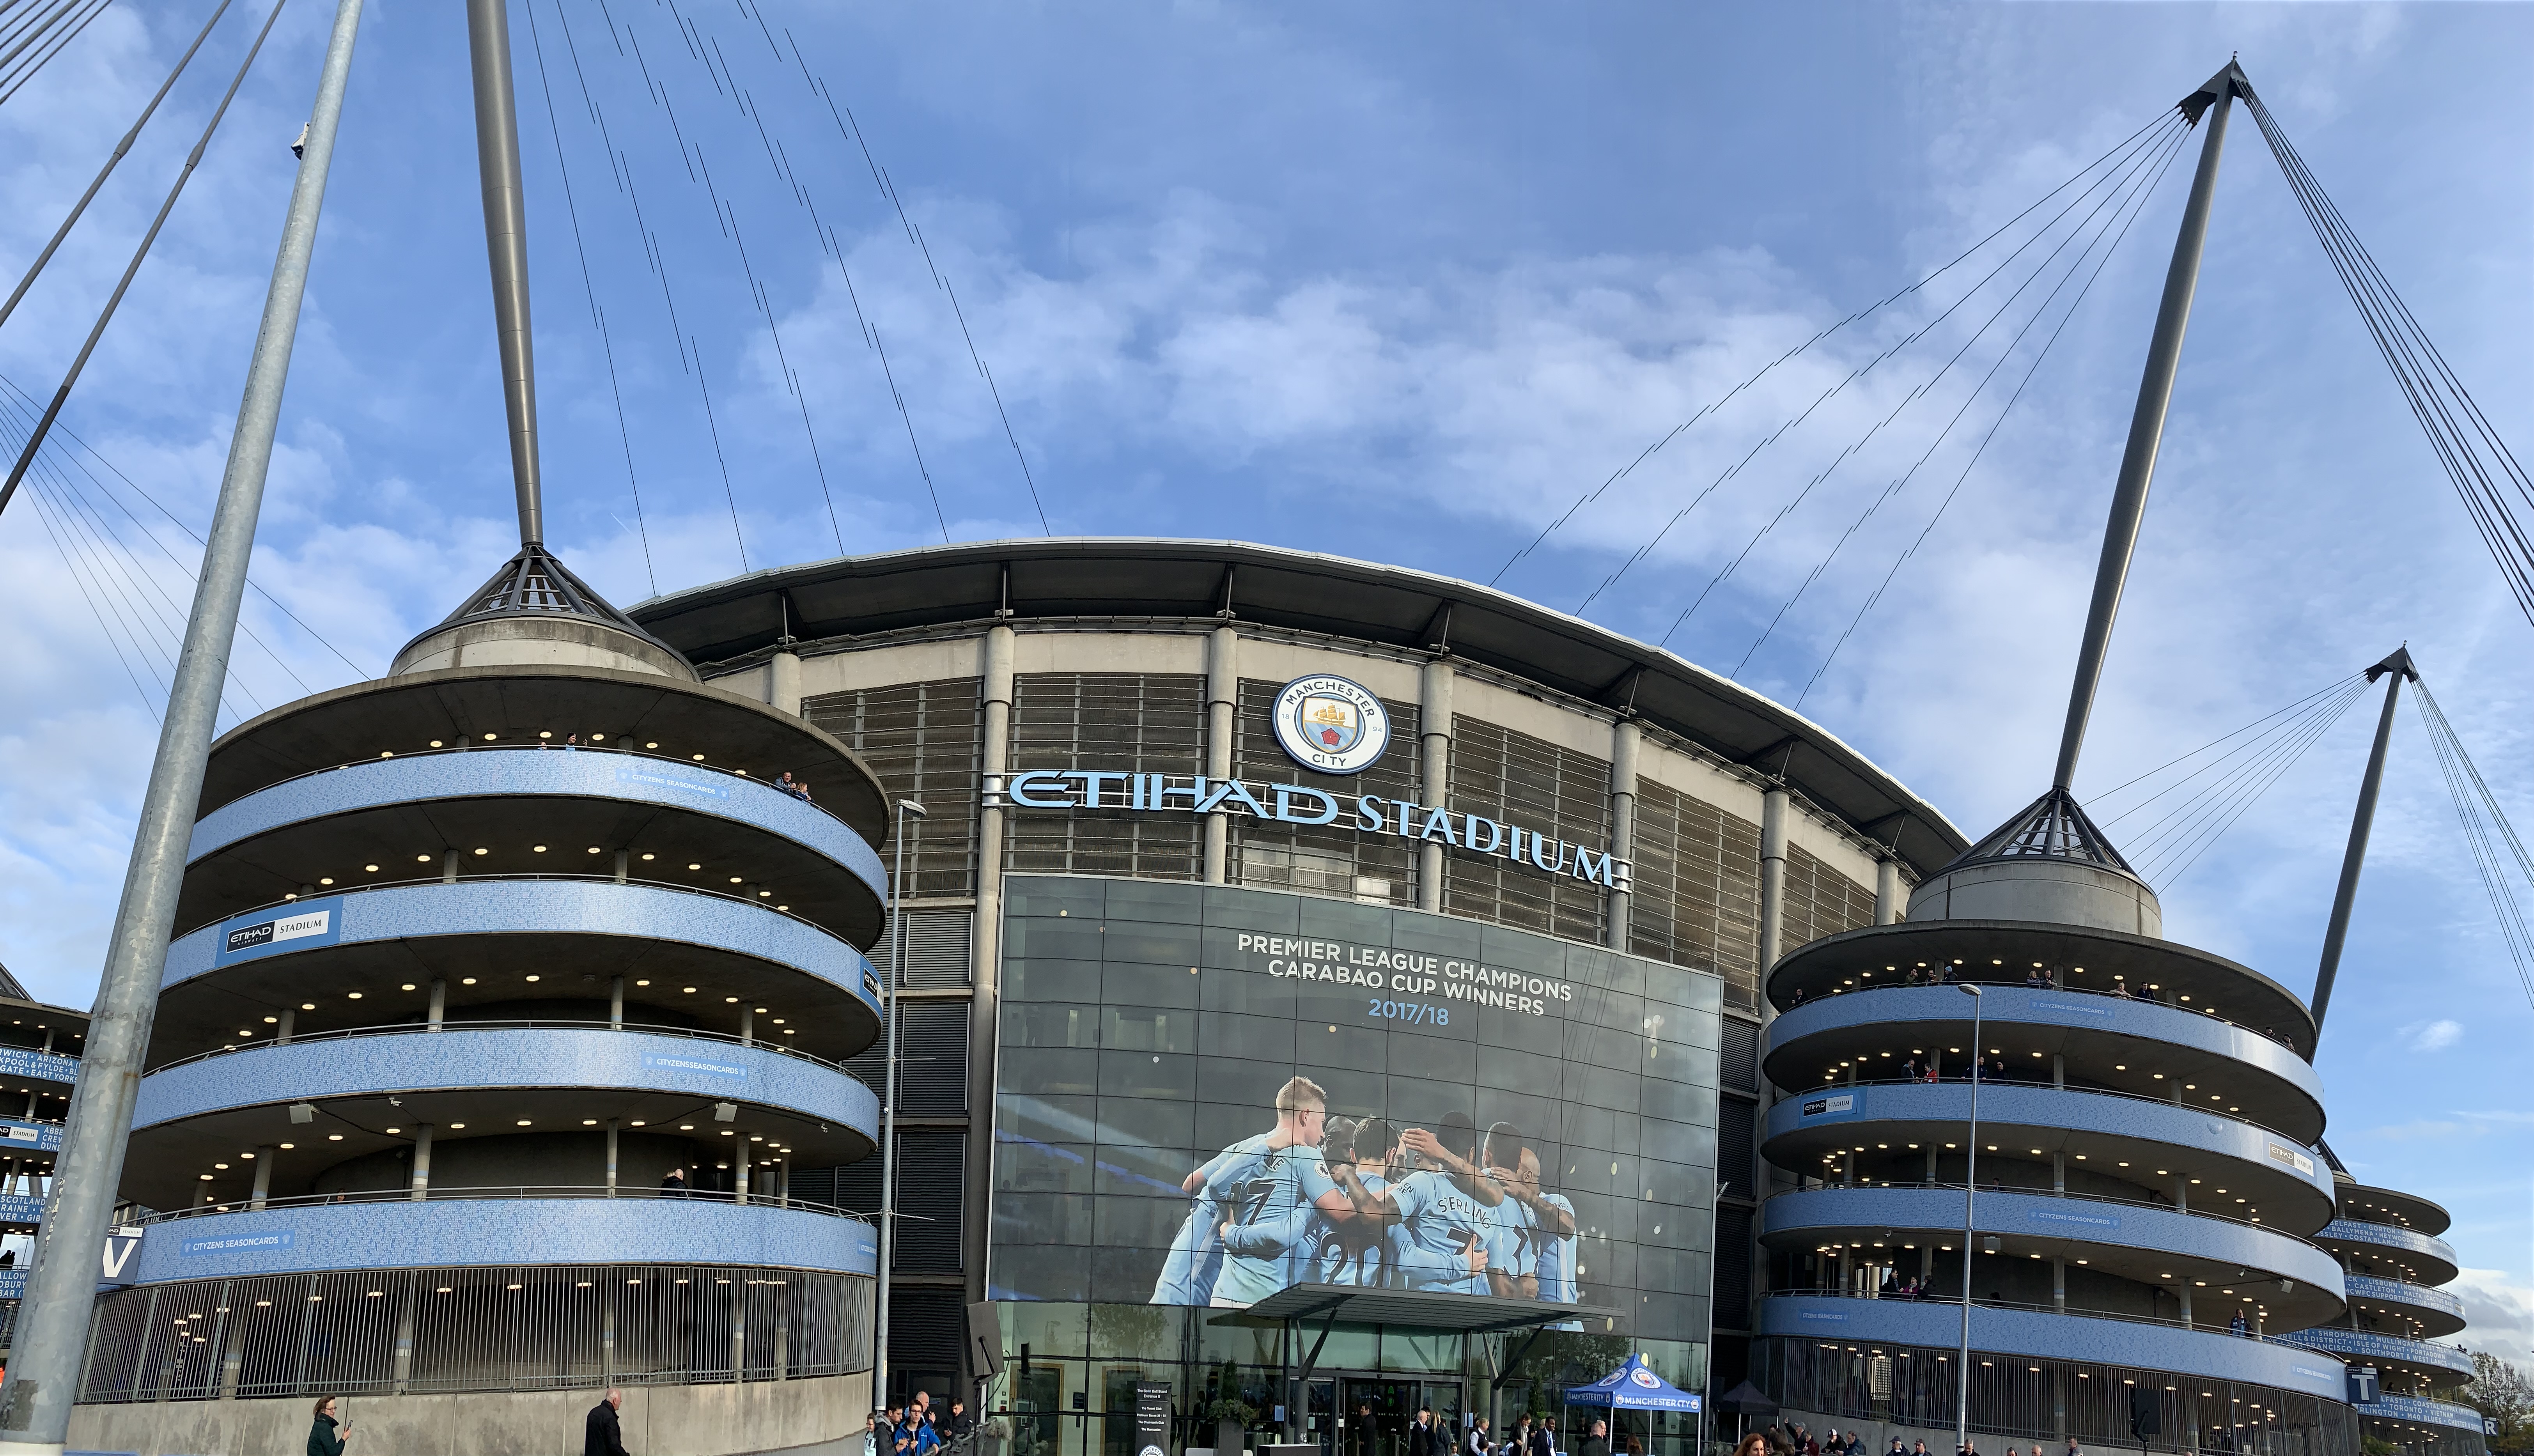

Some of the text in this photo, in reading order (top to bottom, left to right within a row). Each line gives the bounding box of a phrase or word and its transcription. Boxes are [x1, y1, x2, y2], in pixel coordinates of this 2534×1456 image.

[1285, 681, 1375, 717] MANCHESTER
[1312, 754, 1347, 767] CITY
[632, 774, 665, 785] CITYZENS
[1008, 771, 1613, 888] ETIHAD STADIUM
[230, 919, 322, 943] ETIHAD STADIUM
[1238, 933, 1572, 1002] PREMIER LEAGUE CHAMPIONS
[865, 974, 877, 990] ETIHAD
[1268, 959, 1544, 1016] CARABAO CUP WINNERS
[1368, 999, 1450, 1026] 2017/18
[2066, 1005, 2105, 1015] SEASONCARDS
[37, 1055, 73, 1067] ARIZONA
[38, 1063, 64, 1072] FYLDE
[0, 1065, 24, 1074] GATE
[31, 1069, 53, 1079] EAST
[1805, 1102, 1825, 1111] ETIHAD
[2271, 1147, 2293, 1160] ETIHAD
[2297, 1158, 2312, 1171] STADIUM
[0, 1204, 28, 1213] RAINE
[1, 1196, 46, 1206] SCOTLAND
[1437, 1196, 1492, 1229] STERLING
[2068, 1216, 2110, 1225] SEASONCARDS
[2332, 1226, 2374, 1236] BALLYMENA
[2379, 1233, 2410, 1242] HEYWOOD
[2414, 1240, 2429, 1248] BASEL
[2369, 1225, 2396, 1234] GORTON
[2402, 1231, 2428, 1242] ADELAIDE
[193, 1236, 278, 1251] CITYZENS SEASONCARDS
[2349, 1234, 2372, 1242] COSTA
[2373, 1237, 2399, 1247] BLANCA
[2404, 1243, 2427, 1252] GILFORD
[103, 1237, 138, 1278] V
[2354, 1283, 2395, 1294] CASTLETON
[2424, 1295, 2444, 1304] (CACTUS
[2368, 1279, 2397, 1288] LISBURN
[2401, 1284, 2433, 1295] (NORTHERN
[2372, 1291, 2413, 1303] SUPPORTERS
[2318, 1330, 2367, 1341] SHROPSHIRE
[2376, 1337, 2415, 1347] MULLINGAR
[2311, 1336, 2346, 1345] DISTRICT
[2410, 1348, 2445, 1360] PORTADOWN
[2361, 1348, 2404, 1359] SOUTHPORT
[2351, 1375, 2375, 1401] T
[1625, 1397, 1676, 1407] MANCHESTER
[2413, 1400, 2440, 1410] COASTAL
[2441, 1405, 2458, 1413] KIPPAX
[2358, 1407, 2398, 1417] RLINGTON
[2423, 1415, 2442, 1423] BLUES
[2448, 1419, 2467, 1428] CHESTER
[2389, 1404, 2422, 1413] TORONTO
[2430, 1409, 2454, 1418] VIETNAM
[2484, 1421, 2497, 1435] R
